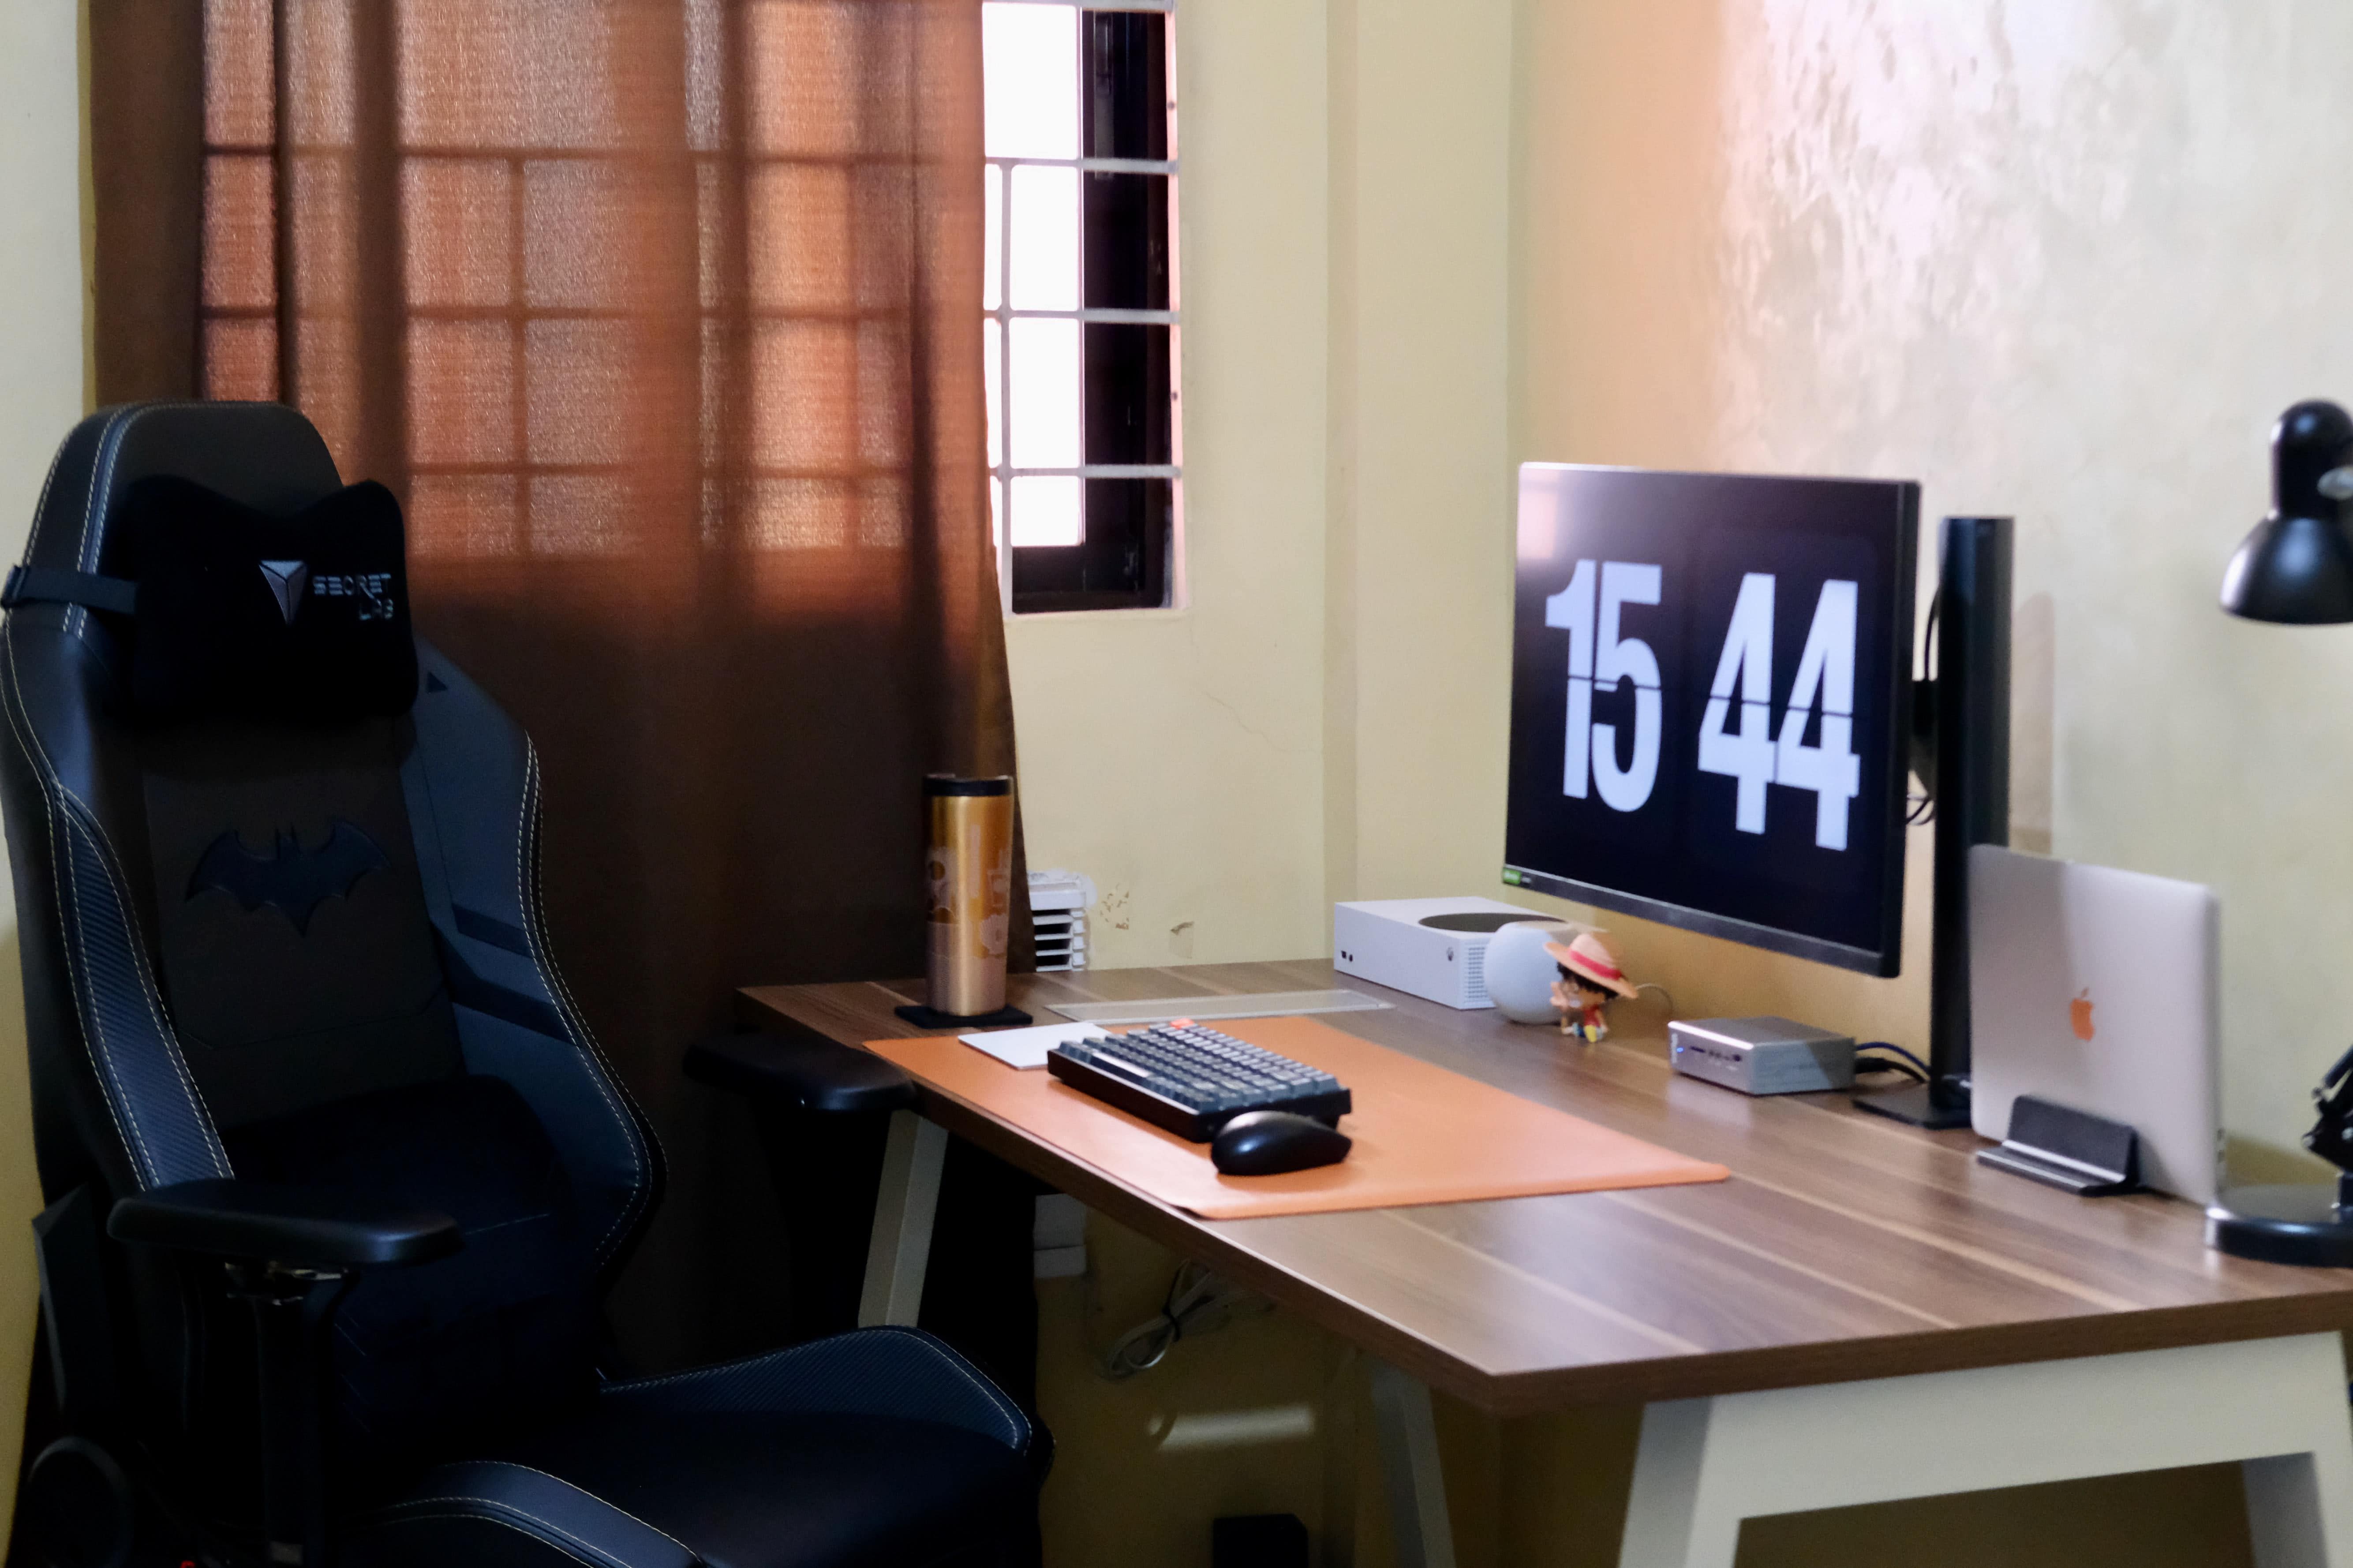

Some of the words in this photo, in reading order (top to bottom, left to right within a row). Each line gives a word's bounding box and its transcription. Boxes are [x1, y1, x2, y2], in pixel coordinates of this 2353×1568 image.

[313, 573, 391, 597] SECRET
[359, 598, 394, 620] LAB
[1545, 559, 1661, 812] 15
[1698, 572, 1860, 851] 44
